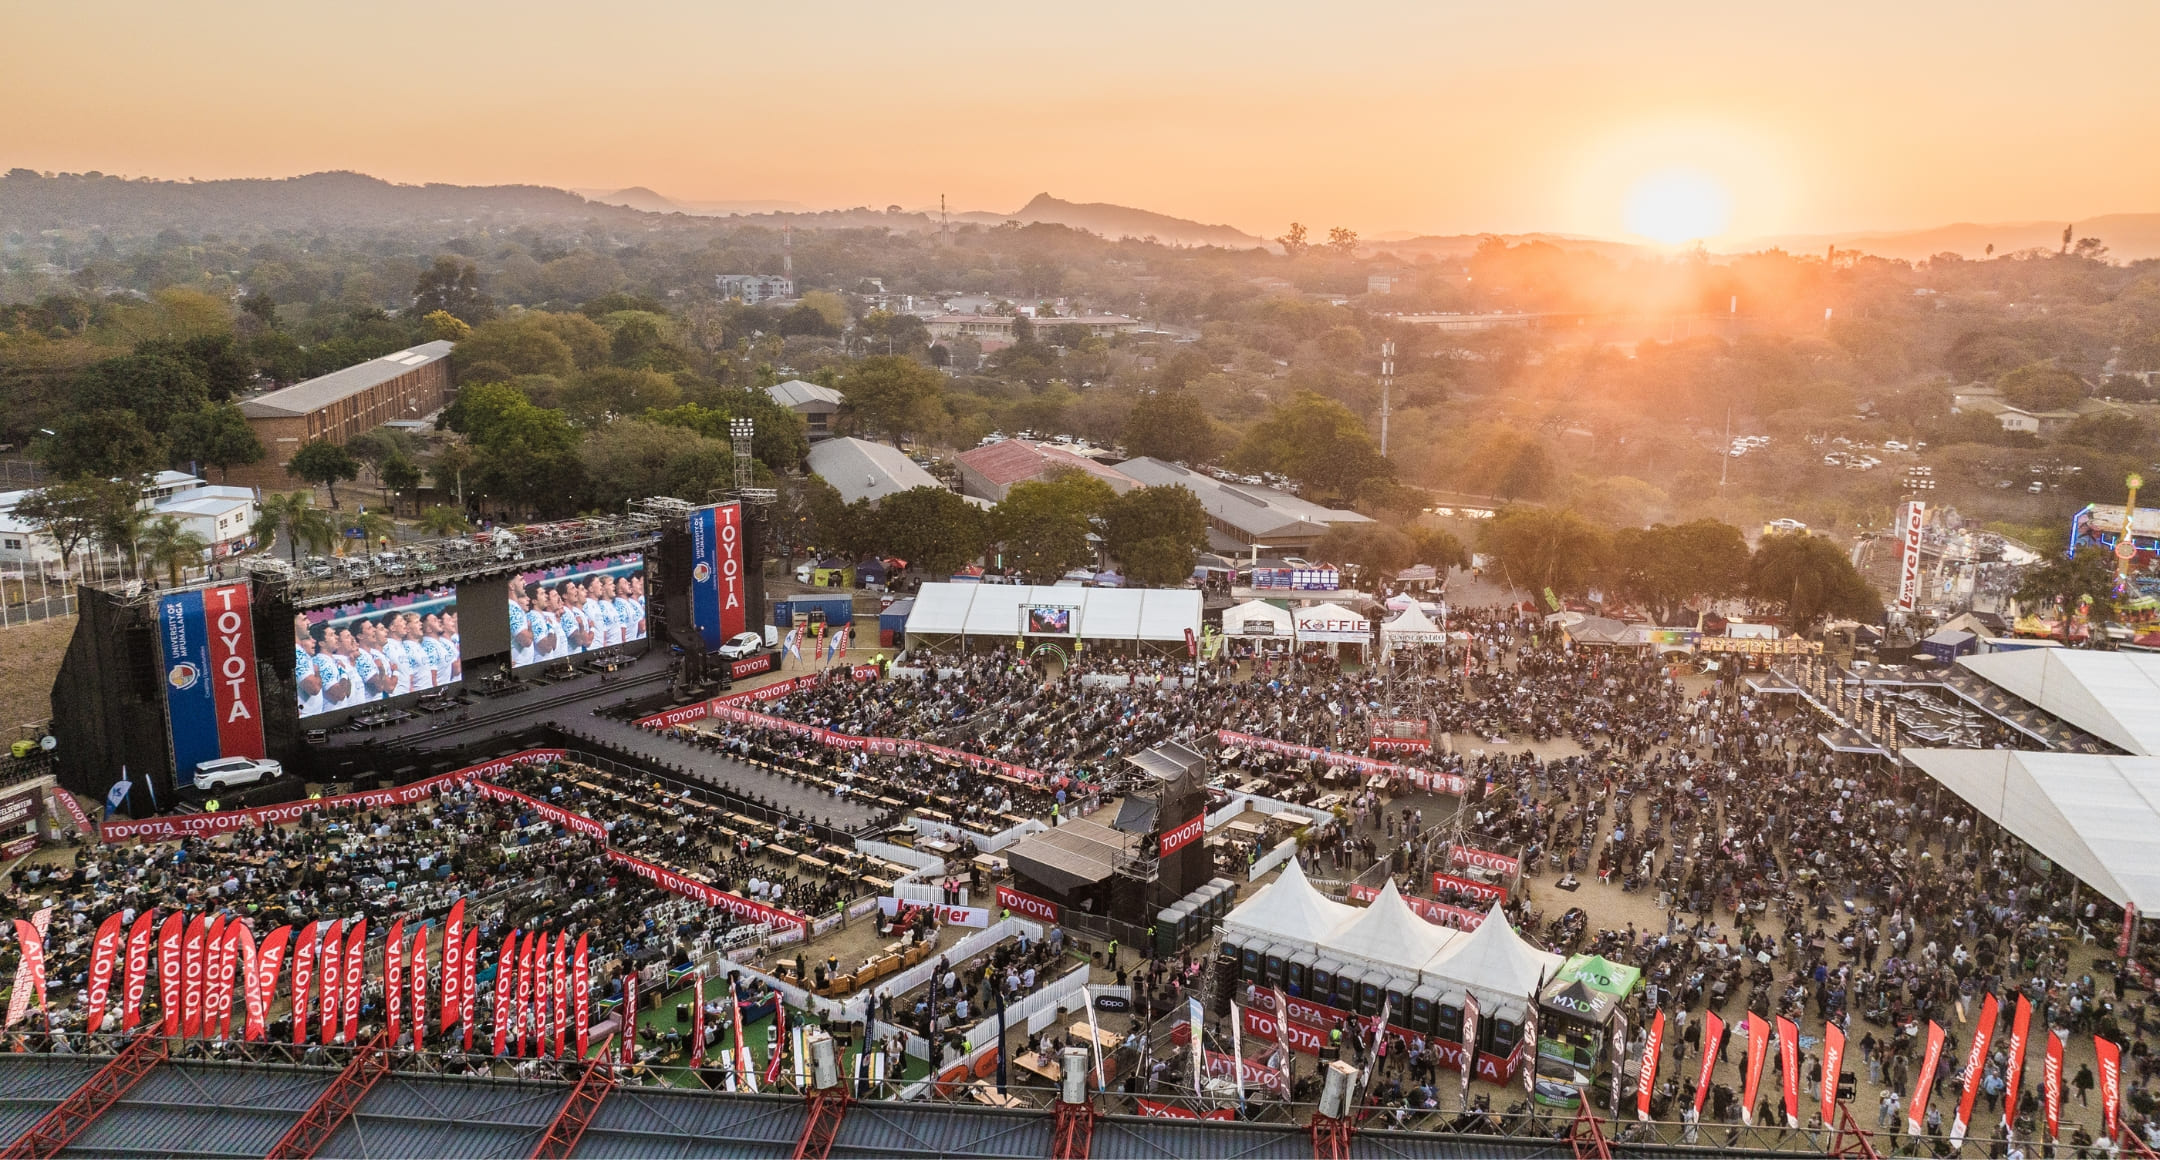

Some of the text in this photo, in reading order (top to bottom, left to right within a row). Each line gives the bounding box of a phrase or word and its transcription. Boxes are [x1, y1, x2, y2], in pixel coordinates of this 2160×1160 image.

[722, 508, 739, 610] TOYOTA
[167, 603, 180, 659] UNIVERSITY OF
[175, 602, 188, 657] MPUMALANGA
[217, 589, 251, 723] TOYOTA
[734, 659, 769, 675] TOYOTA
[667, 706, 705, 723] TOYOTA
[1373, 741, 1425, 752] TOYOTA
[104, 822, 175, 838] TOYOTA
[181, 814, 249, 830] TOYOTA
[1163, 821, 1202, 850] TOYOTA
[662, 873, 707, 900] TOYOTA
[712, 893, 759, 921] TOYOTA
[761, 911, 802, 930] OYOTA
[1000, 891, 1054, 919] TOYOTA
[89, 932, 115, 1016] TOYOTA
[128, 930, 148, 1013] TOYOTA
[163, 933, 180, 1020] TOYOTA
[185, 935, 201, 1020] TOYOTA
[205, 936, 220, 1022] TOYOTA
[294, 943, 312, 1025] TOYOTA
[322, 939, 338, 1026] TOYOTA
[344, 940, 362, 1026] TOYOTA
[388, 938, 400, 1026] TOYOTA
[444, 920, 460, 1007] TOYOTA
[463, 948, 475, 1034] TOYOTA
[494, 949, 512, 1037] TOYOTA
[517, 953, 530, 1041] TOYOTA
[537, 954, 546, 1042] TOYOTA
[555, 951, 565, 1039] TOYOTA
[575, 953, 587, 1040] TOYOTA
[1100, 999, 1124, 1007] oppo
[1552, 995, 1590, 1012] MXD
[1254, 992, 1323, 1025] TOOTA
